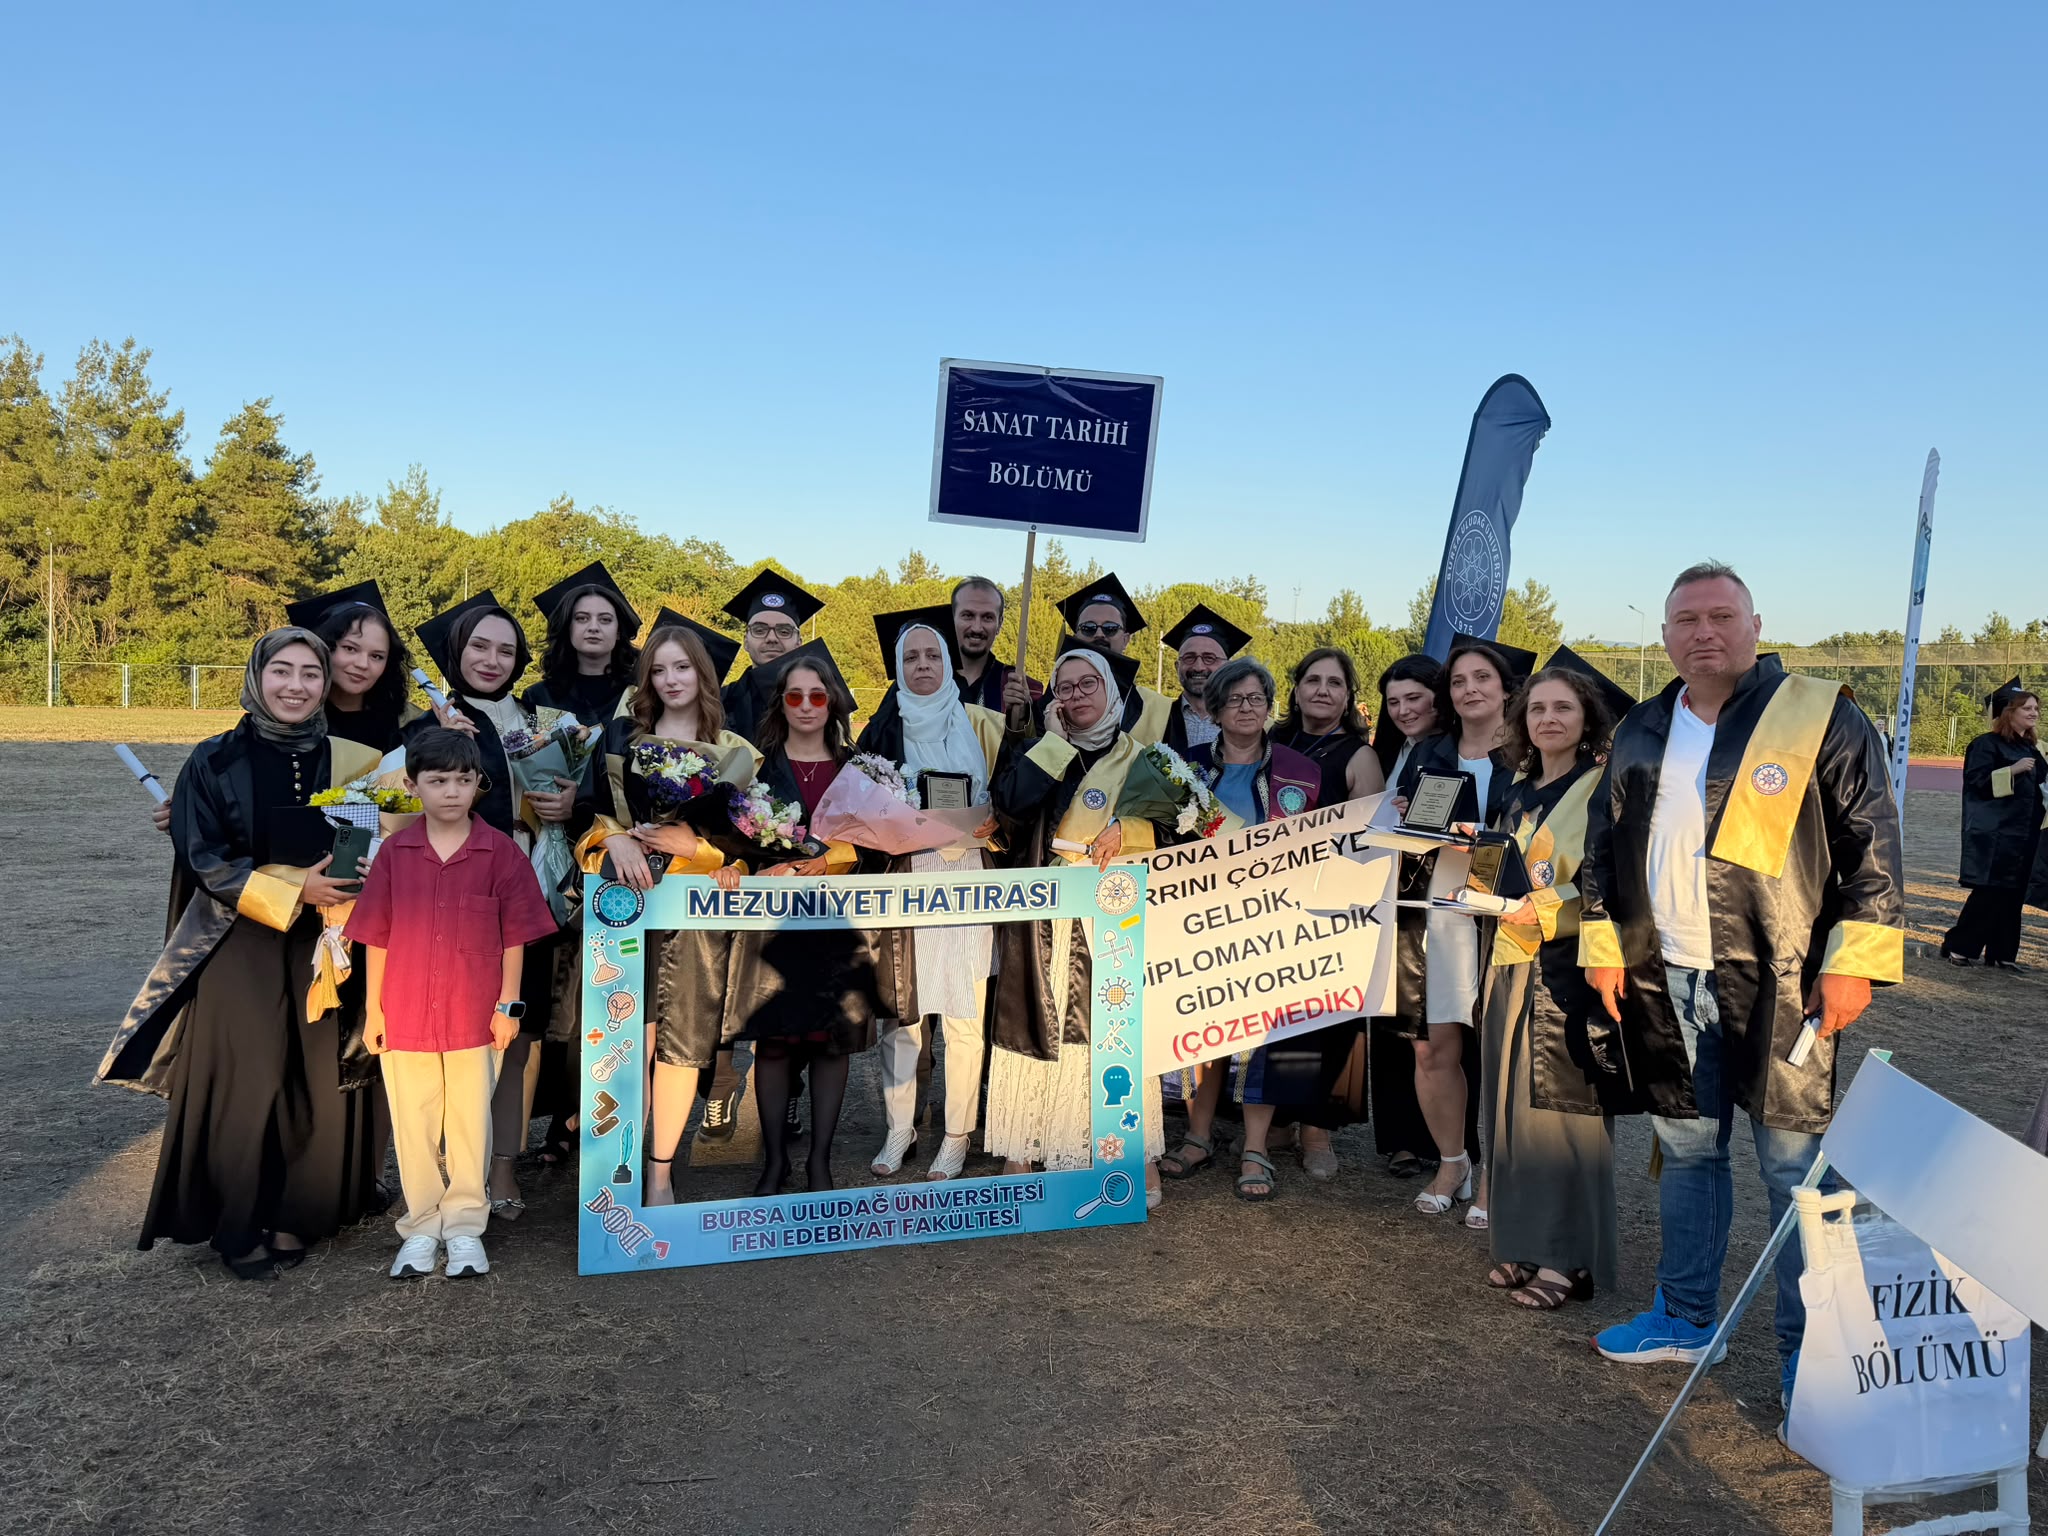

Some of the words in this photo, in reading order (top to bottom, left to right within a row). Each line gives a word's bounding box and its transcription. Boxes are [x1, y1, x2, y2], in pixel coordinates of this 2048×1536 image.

[963, 409, 1039, 438] SANAT
[1045, 415, 1129, 446] TARİHİ
[988, 461, 1093, 493] BÖLÜMÜ
[1446, 535, 1461, 580] BURSA
[1460, 514, 1485, 535] ULUDAĞ
[1453, 616, 1473, 636] 1975
[1228, 803, 1346, 857] LİSA'NIN
[1145, 873, 1217, 907] RRINI
[1226, 829, 1370, 888] ÇÖZMEYE
[688, 882, 894, 917] MEZUNİYET
[901, 881, 1058, 916] HATIRASI
[1182, 887, 1301, 935] GELDİK,
[1142, 929, 1284, 988] İPLOMAYI
[1293, 904, 1382, 947] ALDIK
[1174, 951, 1344, 1016] GİDİYORUZ!
[1171, 984, 1365, 1062] (ÇÖZEMEDİK)
[702, 1207, 785, 1231] BURSA
[791, 1192, 889, 1222] ULUDAĞ
[895, 1179, 1044, 1212] ÜNİVERSİTESİ
[732, 1231, 776, 1252] FEN
[783, 1219, 896, 1247] EDEBİYAT
[902, 1204, 1020, 1235] FAKÜLTESİ
[1870, 1269, 1971, 1322] FİZİK
[1851, 1330, 2009, 1395] BÖLÜMÜ
